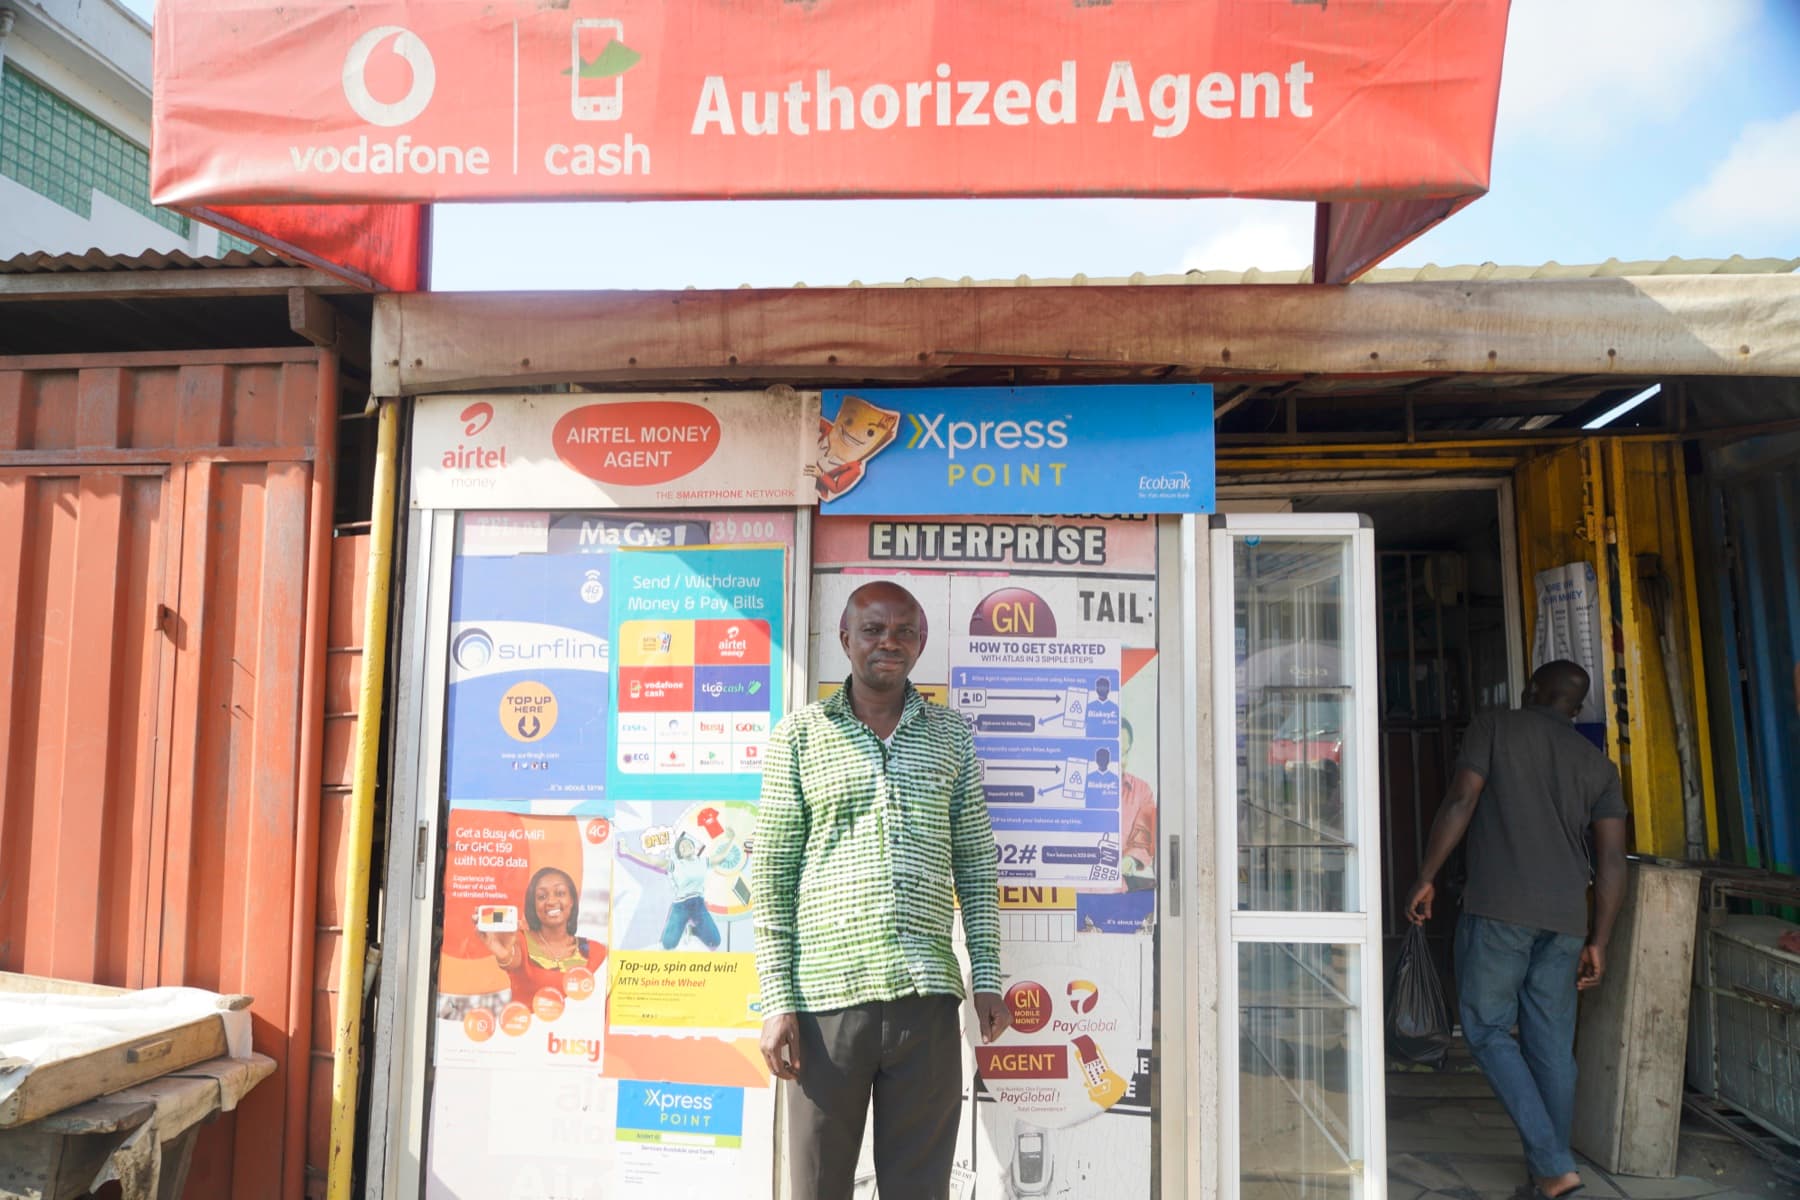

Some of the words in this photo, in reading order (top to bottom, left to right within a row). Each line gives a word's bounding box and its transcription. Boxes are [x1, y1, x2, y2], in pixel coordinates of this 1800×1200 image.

[691, 60, 1078, 136] Authorized
[1097, 60, 1315, 139] Agent
[289, 136, 490, 176] vodafone
[545, 134, 651, 177] cash
[566, 427, 635, 444] AIRTEL
[641, 425, 711, 443] MONEY
[918, 413, 1069, 460] Xpress
[442, 446, 508, 470] airtel
[604, 451, 673, 468] AGENT
[949, 463, 1068, 488] POINT
[1138, 471, 1192, 490] Ecobank
[451, 477, 497, 491] money
[656, 491, 674, 500] THE
[675, 490, 744, 500] SMARTPHONE
[746, 489, 795, 499] NETWORK
[869, 521, 1107, 566] ENTERPRISE
[633, 575, 670, 589] Send
[685, 574, 760, 589] Withdraw
[628, 597, 680, 612] Money
[684, 597, 695, 610] &
[700, 597, 728, 613] Pay
[733, 595, 764, 609] Bills
[991, 602, 1035, 633] GN
[498, 638, 609, 660] surfline
[718, 639, 746, 650] airtel
[969, 641, 1001, 653] HOW
[1003, 642, 1019, 653] TO
[1022, 643, 1046, 654] GET
[1049, 643, 1106, 655] STARTED
[981, 655, 1001, 663] WITH
[1002, 655, 1026, 663] ATLAS
[1027, 655, 1034, 663] IN
[1035, 655, 1040, 663] 3
[1042, 655, 1068, 663] SIMPLE
[1069, 656, 1094, 664] STEPS
[644, 680, 684, 690] vodafone
[959, 672, 967, 684] 1
[507, 696, 532, 705] TOP
[534, 696, 552, 705] UP
[644, 689, 664, 697] cash
[972, 693, 983, 702] ID
[700, 721, 724, 734] busy
[633, 752, 650, 761] ECG
[455, 827, 472, 839] Get
[474, 830, 481, 839] a
[482, 828, 507, 841] Busy
[508, 828, 523, 839] 4G
[588, 824, 607, 838] 4G
[455, 841, 469, 851] for
[471, 841, 493, 852] GHC
[495, 842, 512, 853] 159
[454, 855, 477, 866] with
[505, 856, 528, 868] data
[619, 959, 661, 974] Top-up,
[663, 961, 687, 974] spin
[689, 962, 712, 973] and
[713, 962, 737, 973] win!
[618, 976, 639, 986] MTN
[640, 978, 660, 988] Spin
[661, 978, 676, 987] the
[678, 978, 706, 988] Wheel
[1015, 989, 1040, 1008] GN
[1052, 1018, 1118, 1035] PayGlobal
[547, 1031, 600, 1061] busy
[989, 1053, 1056, 1072] AGENT
[648, 1088, 713, 1111] Xpress
[1000, 1091, 1055, 1105] PayGlobal
[660, 1113, 712, 1128] POINT
